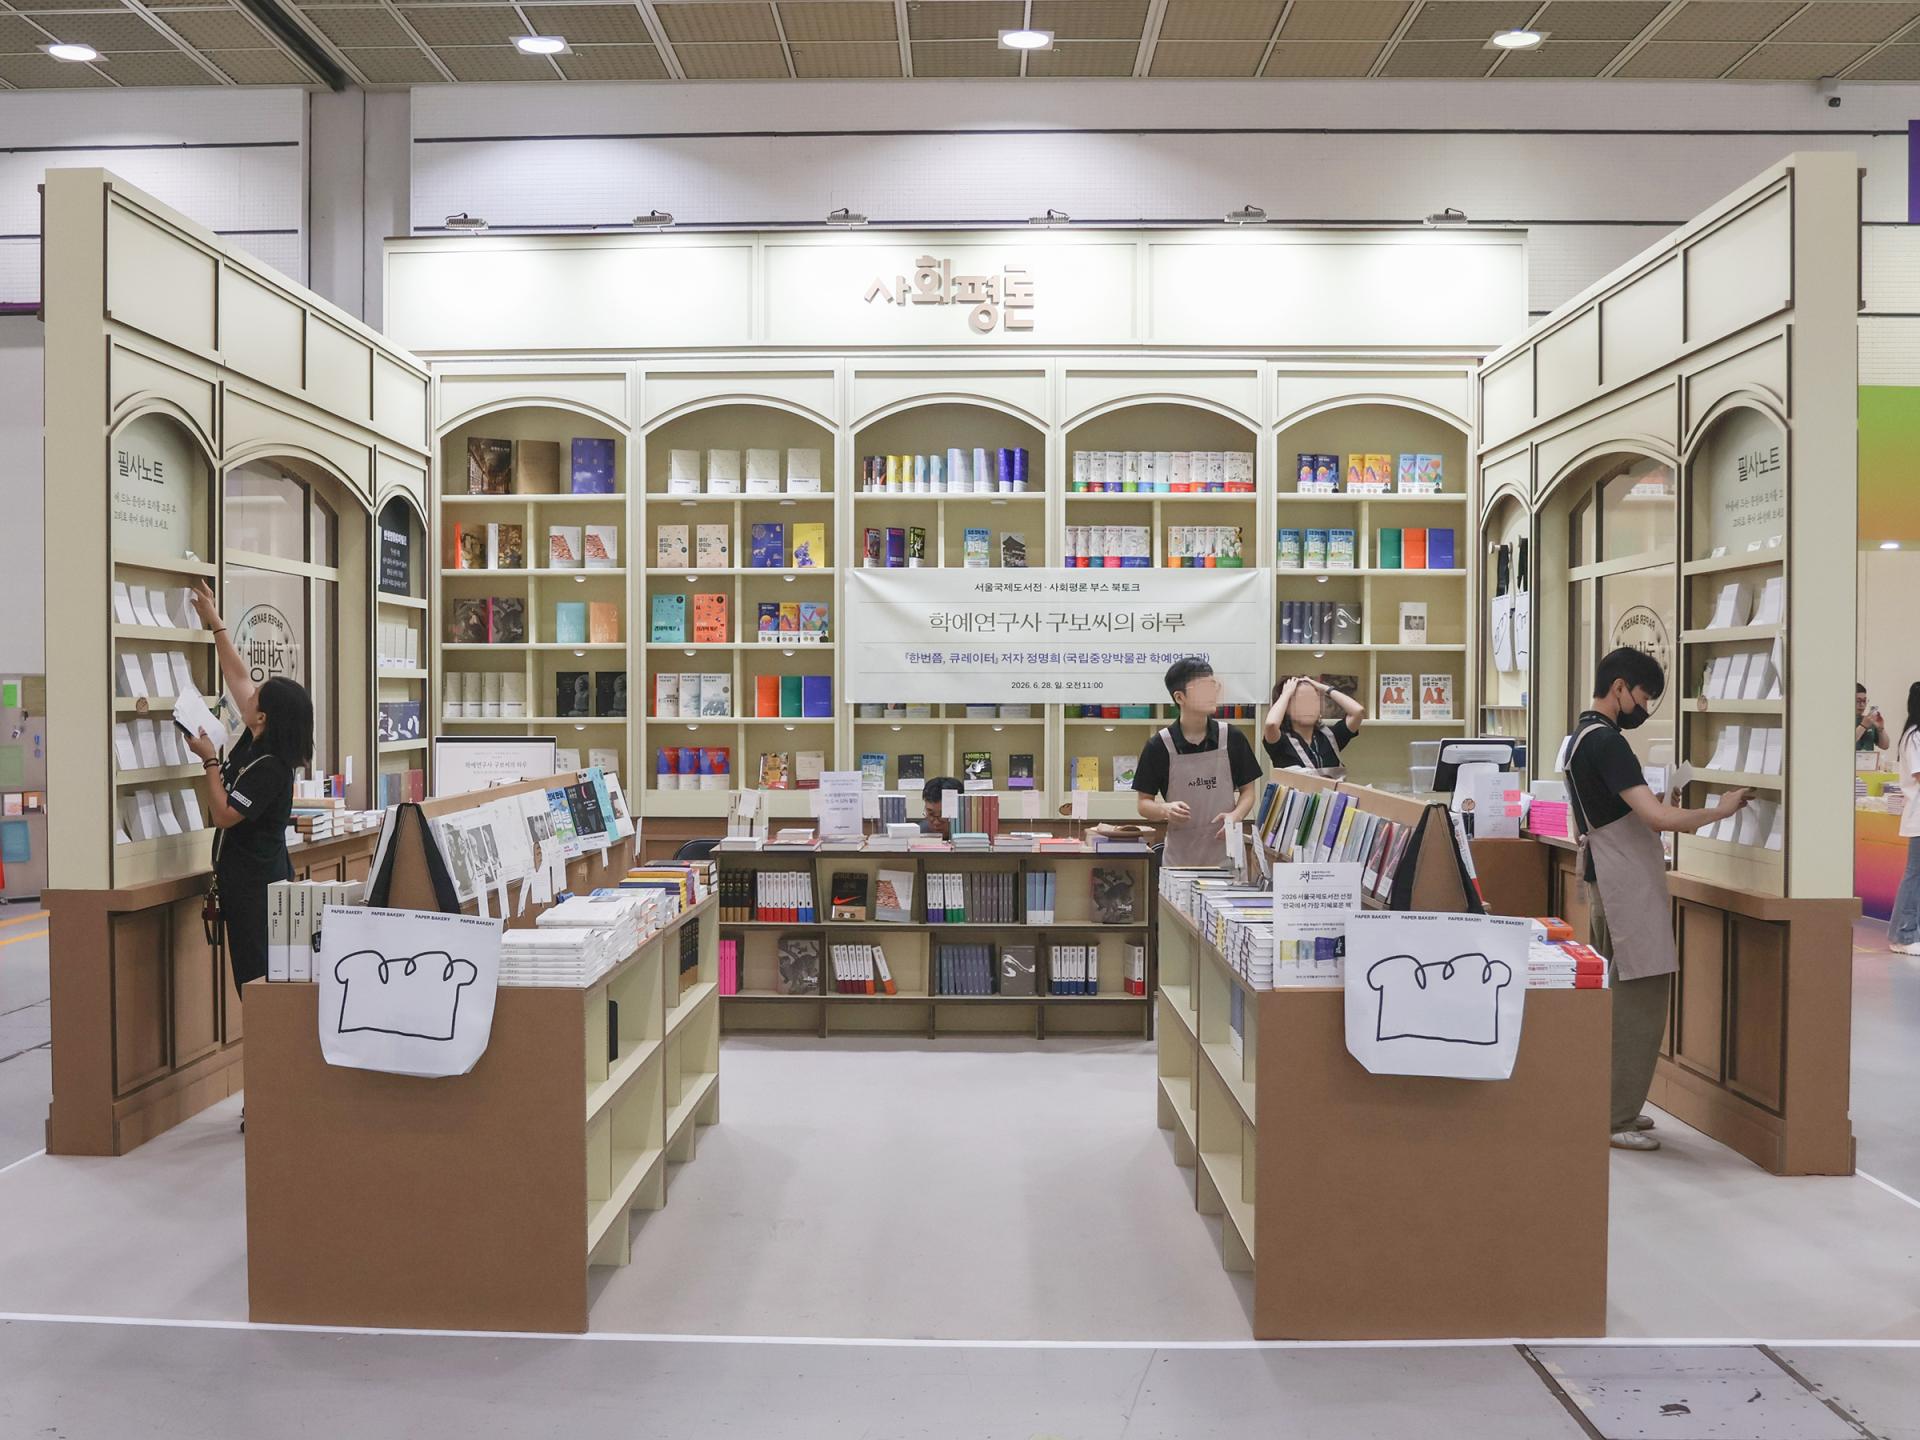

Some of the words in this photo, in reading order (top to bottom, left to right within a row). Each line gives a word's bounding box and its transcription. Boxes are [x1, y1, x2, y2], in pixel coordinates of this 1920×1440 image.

[864, 255, 1034, 334] 사회평론
[118, 450, 164, 485] 필사노트
[1738, 446, 1780, 482] 필사노트
[974, 582, 1043, 593] 서울국제도서전
[1049, 582, 1088, 593] 사회평론
[1089, 582, 1109, 593] 부스
[1111, 582, 1140, 593] 북토크
[928, 611, 1043, 633] 학예연구사
[1046, 611, 1135, 633] 구보씨의
[1140, 611, 1186, 633] 하루
[1001, 652, 1024, 664] 저자
[1026, 652, 1061, 665] 정명희
[1063, 652, 1147, 665] (국립중앙박물관
[1382, 686, 1405, 705] AI
[1423, 686, 1446, 705] AI
[1188, 776, 1217, 790] 사회평론
